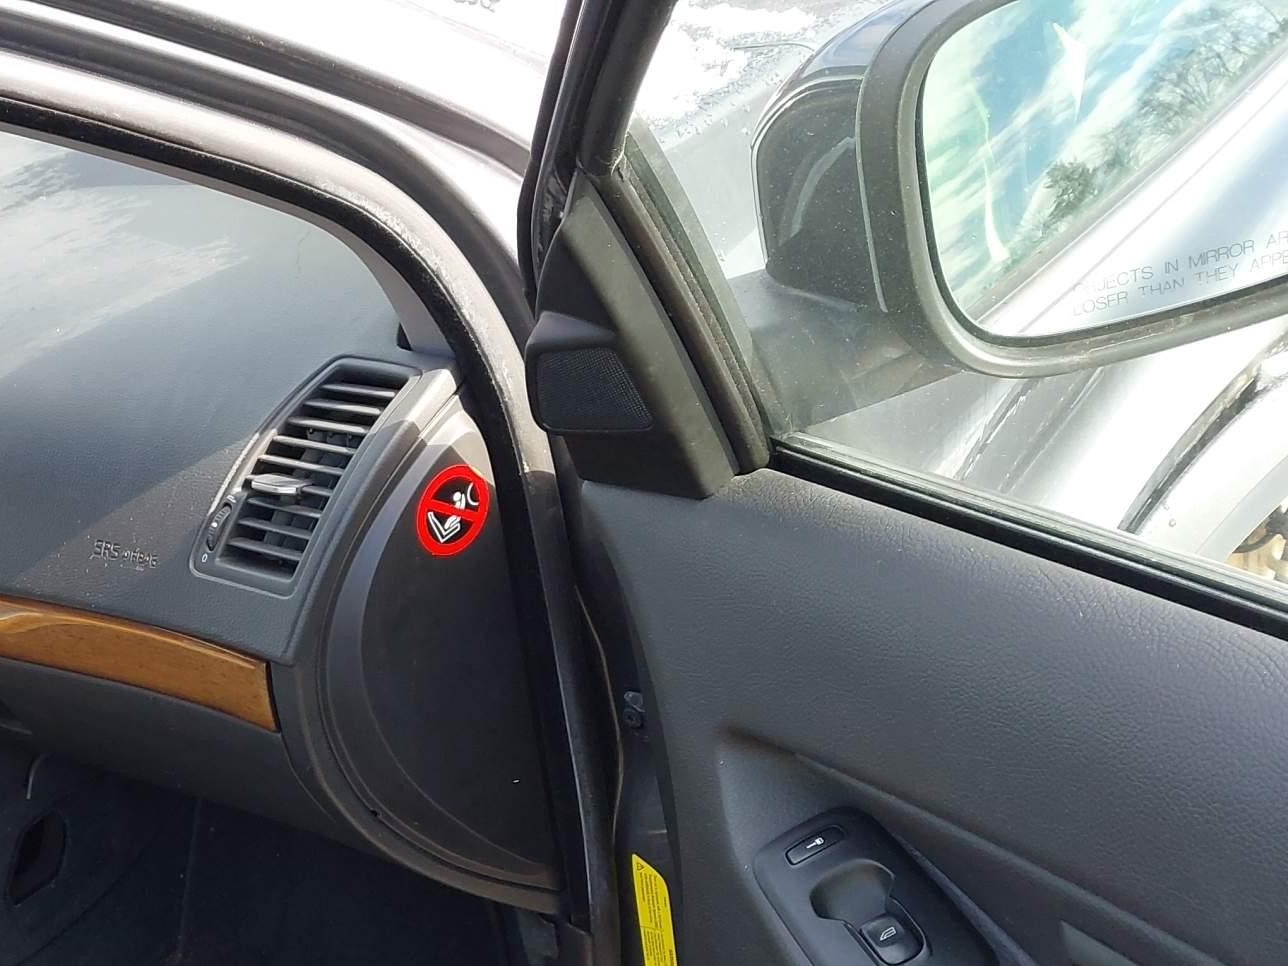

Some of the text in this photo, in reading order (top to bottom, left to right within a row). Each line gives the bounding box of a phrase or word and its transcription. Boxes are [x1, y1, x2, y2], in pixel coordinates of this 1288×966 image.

[1164, 258, 1179, 274] IN
[1189, 239, 1255, 270] MIRROR
[1138, 277, 1185, 296] THAN
[1193, 263, 1239, 285] THEY
[92, 540, 120, 560] SRS
